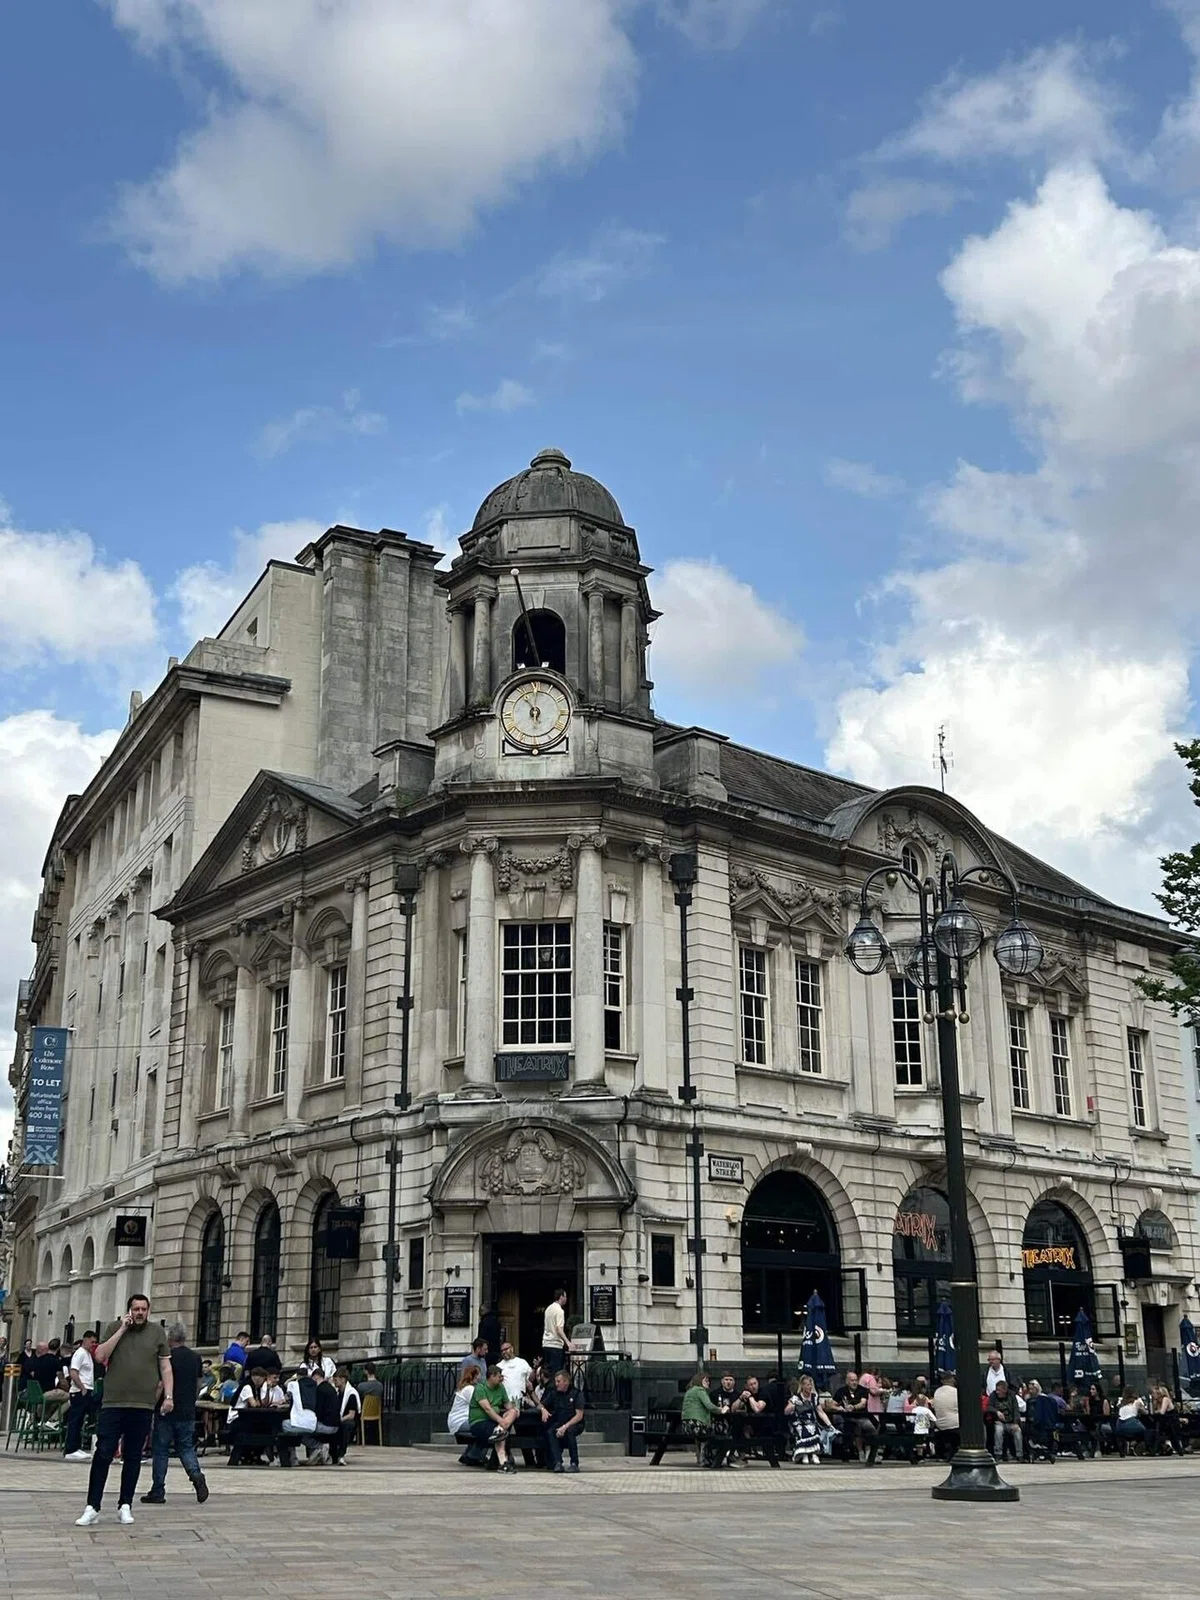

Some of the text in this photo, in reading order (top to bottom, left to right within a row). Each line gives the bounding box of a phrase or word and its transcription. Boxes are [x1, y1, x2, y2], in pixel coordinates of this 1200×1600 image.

[498, 1055, 567, 1080] THEATRIX
[32, 1078, 61, 1087] TO LET
[52, 1111, 59, 1119] ft
[712, 1160, 740, 1169] WATERLOO
[715, 1168, 737, 1177] STREET
